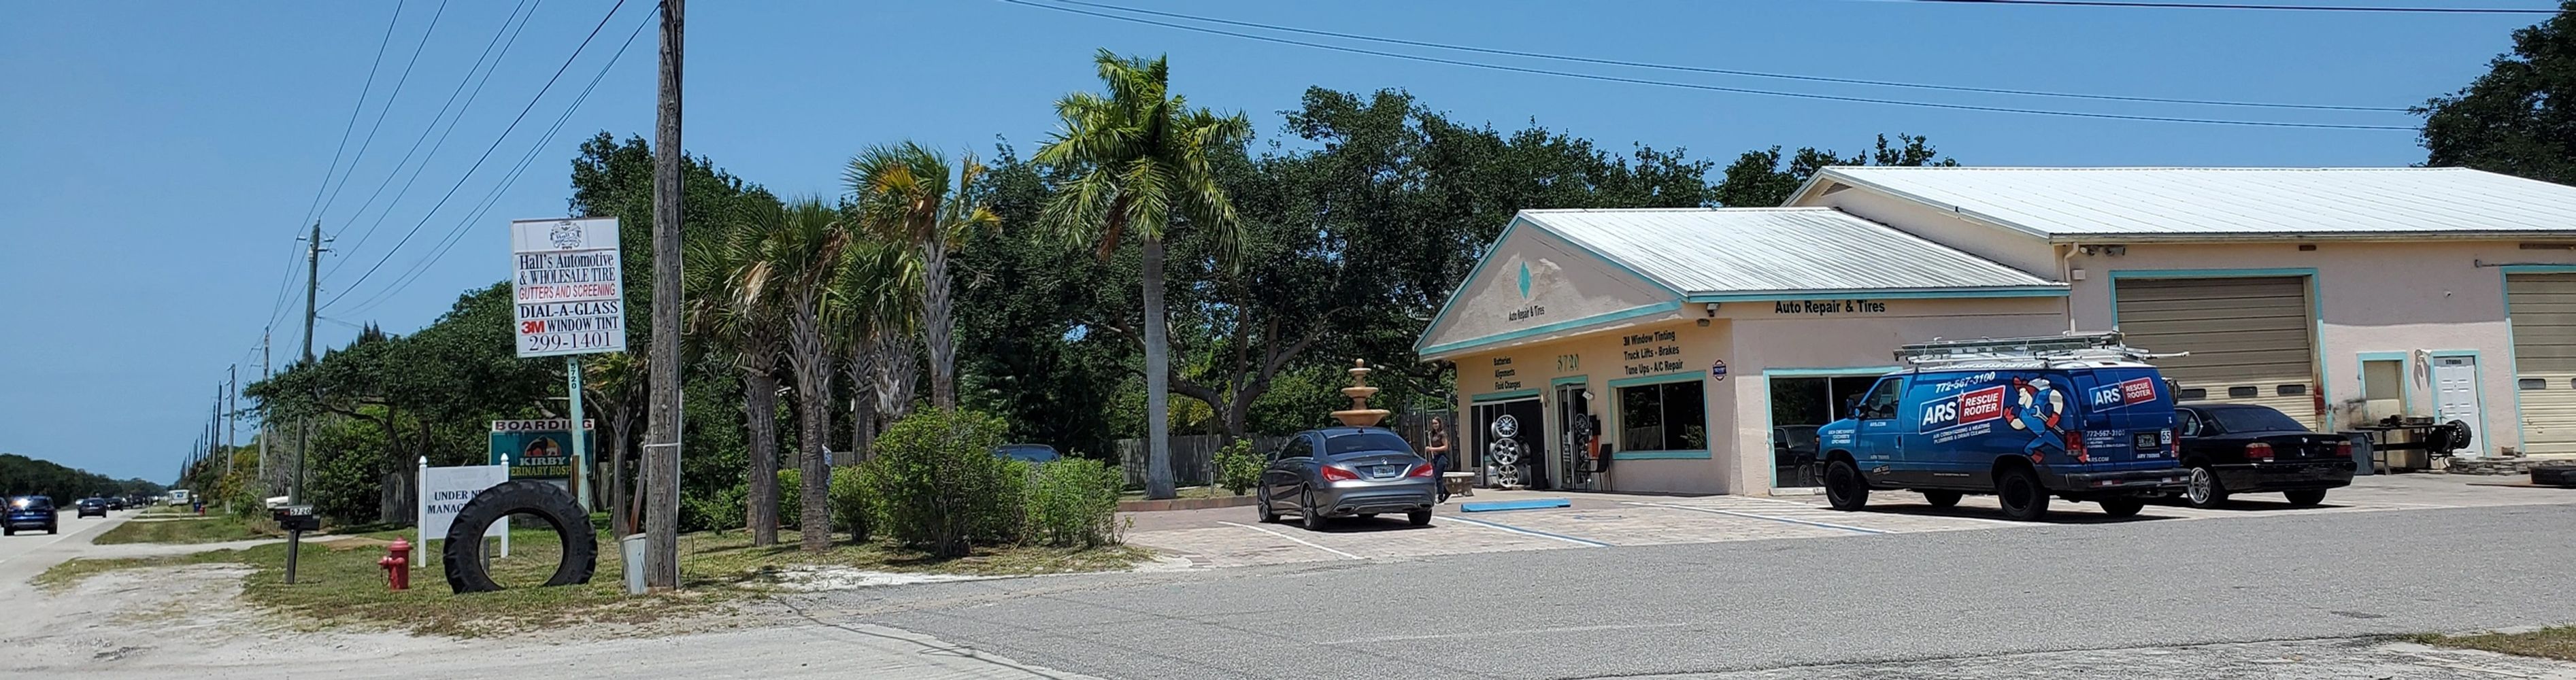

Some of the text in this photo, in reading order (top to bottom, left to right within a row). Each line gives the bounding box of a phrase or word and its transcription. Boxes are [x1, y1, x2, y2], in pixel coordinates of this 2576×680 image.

[520, 252, 614, 270] Hall's Automotive
[519, 267, 615, 286] & WHOLESALE TIRE
[519, 283, 616, 300] GUTTERS AND SCREENING
[520, 301, 618, 318] DIAL-A-GLASS
[1509, 311, 1518, 322] Auto
[1518, 307, 1530, 321] Repair
[1535, 305, 1545, 316] Tires
[1775, 299, 1886, 316] Auto Repair & Tires
[521, 316, 618, 334] 3M WINDOW TINT
[529, 331, 612, 351] 299-1401
[1623, 330, 1675, 346] 3M Window Tinting
[1624, 351, 1639, 360] Truck
[1641, 347, 1654, 358] Lifts
[1658, 345, 1679, 356] Brakes
[1494, 356, 1511, 366] Batteries
[1558, 354, 1579, 372] 5720
[1625, 366, 1638, 375] Tune
[1639, 364, 1650, 375] Ups
[1665, 359, 1684, 373] Repair
[1495, 369, 1516, 379] Alignments
[1935, 371, 1996, 393] 772-567-3100
[1495, 380, 1521, 390] Fluid Changes
[2126, 382, 2150, 392] RESCUE
[1964, 392, 1998, 407] RESCUE
[2095, 388, 2121, 406] ARS
[2127, 390, 2150, 399] ROOTER
[1922, 401, 1957, 426] ARS
[1964, 403, 1997, 417] ROOTER
[495, 420, 593, 430] BOARDIG
[1971, 428, 1991, 437] CLEANING
[2162, 431, 2170, 441] 65
[520, 456, 567, 466] KIRBY
[435, 490, 468, 500] UNDER
